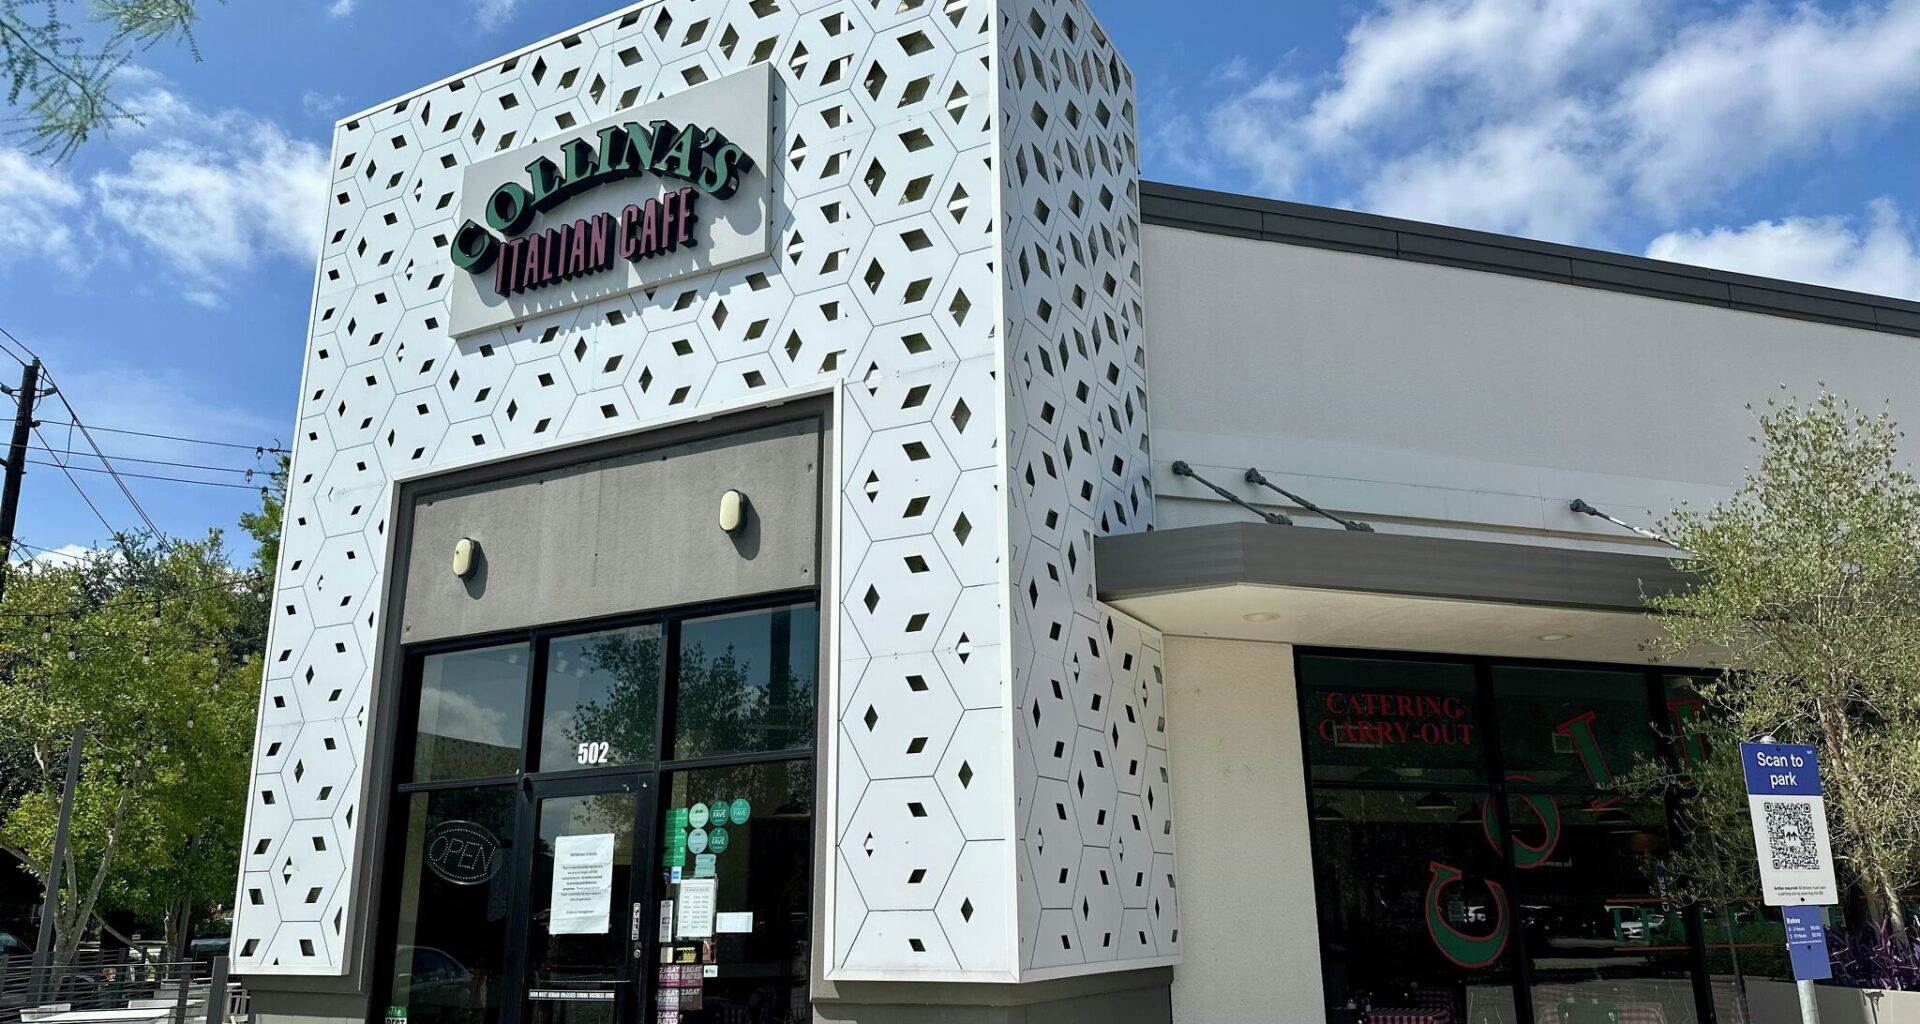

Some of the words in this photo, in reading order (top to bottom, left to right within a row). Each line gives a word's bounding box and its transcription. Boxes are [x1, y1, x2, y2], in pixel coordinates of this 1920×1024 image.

[450, 119, 750, 273] COLLINA'S
[494, 213, 614, 296] ITALIAN
[619, 186, 698, 262] CAFE
[1324, 692, 1465, 719] CATERING
[1317, 718, 1474, 746] CARRY-OUT
[577, 741, 609, 764] 502
[1756, 751, 1788, 767] Scan
[1790, 753, 1804, 768] to
[1769, 771, 1798, 789] park
[429, 835, 496, 872] OPEN
[680, 988, 700, 996] ZAGAT
